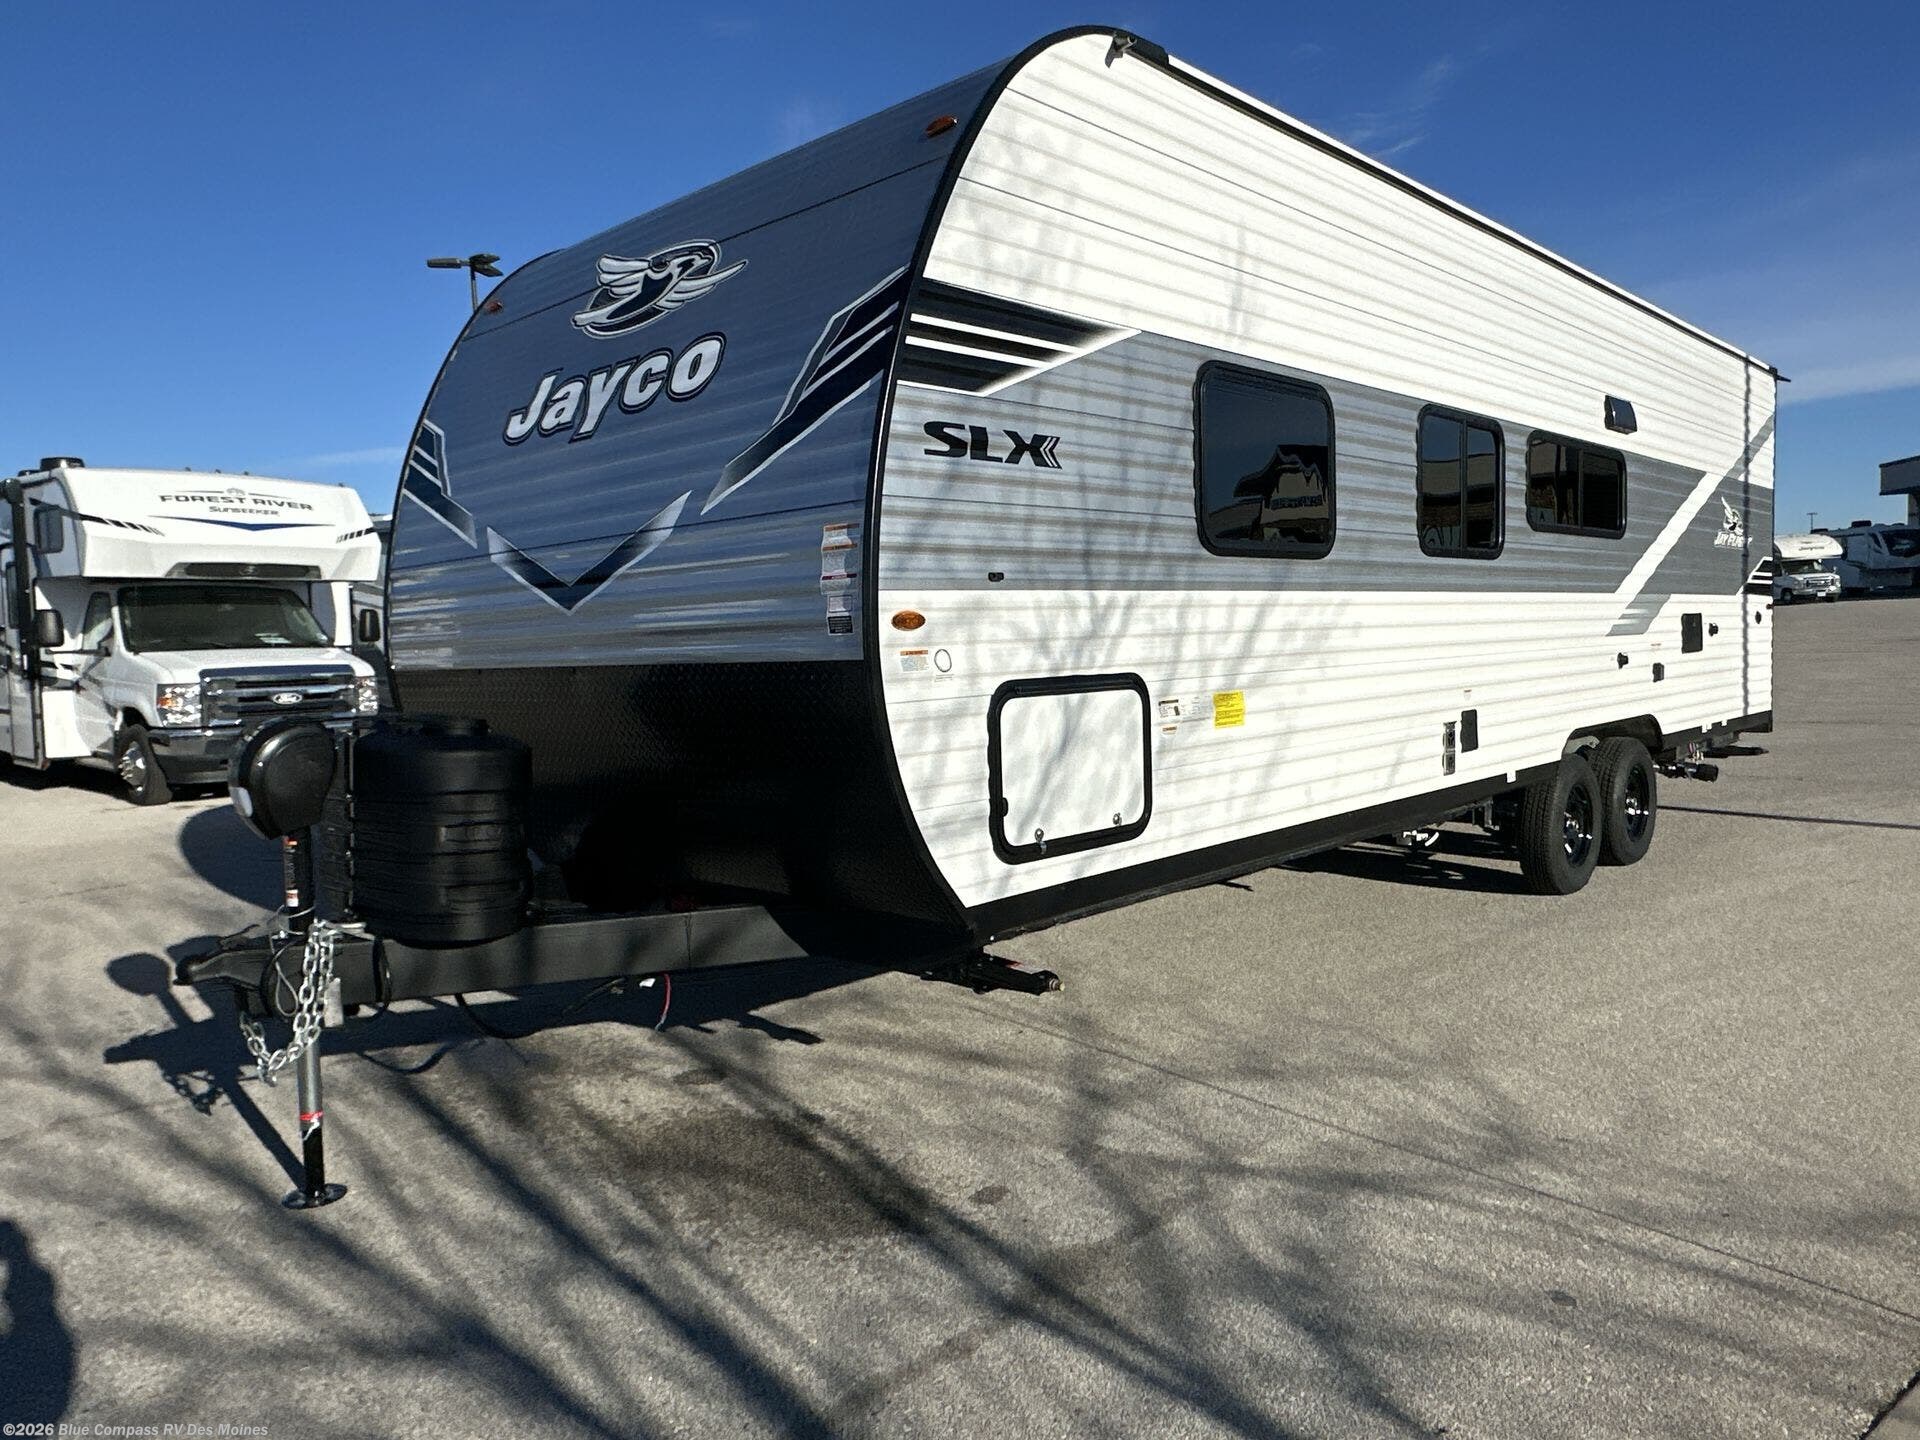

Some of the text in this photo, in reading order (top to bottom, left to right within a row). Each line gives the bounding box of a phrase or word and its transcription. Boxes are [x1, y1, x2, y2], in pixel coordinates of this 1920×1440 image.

[504, 332, 726, 445] Jayco
[923, 420, 1062, 469] SLX
[159, 494, 314, 511] FOREST RIVER
